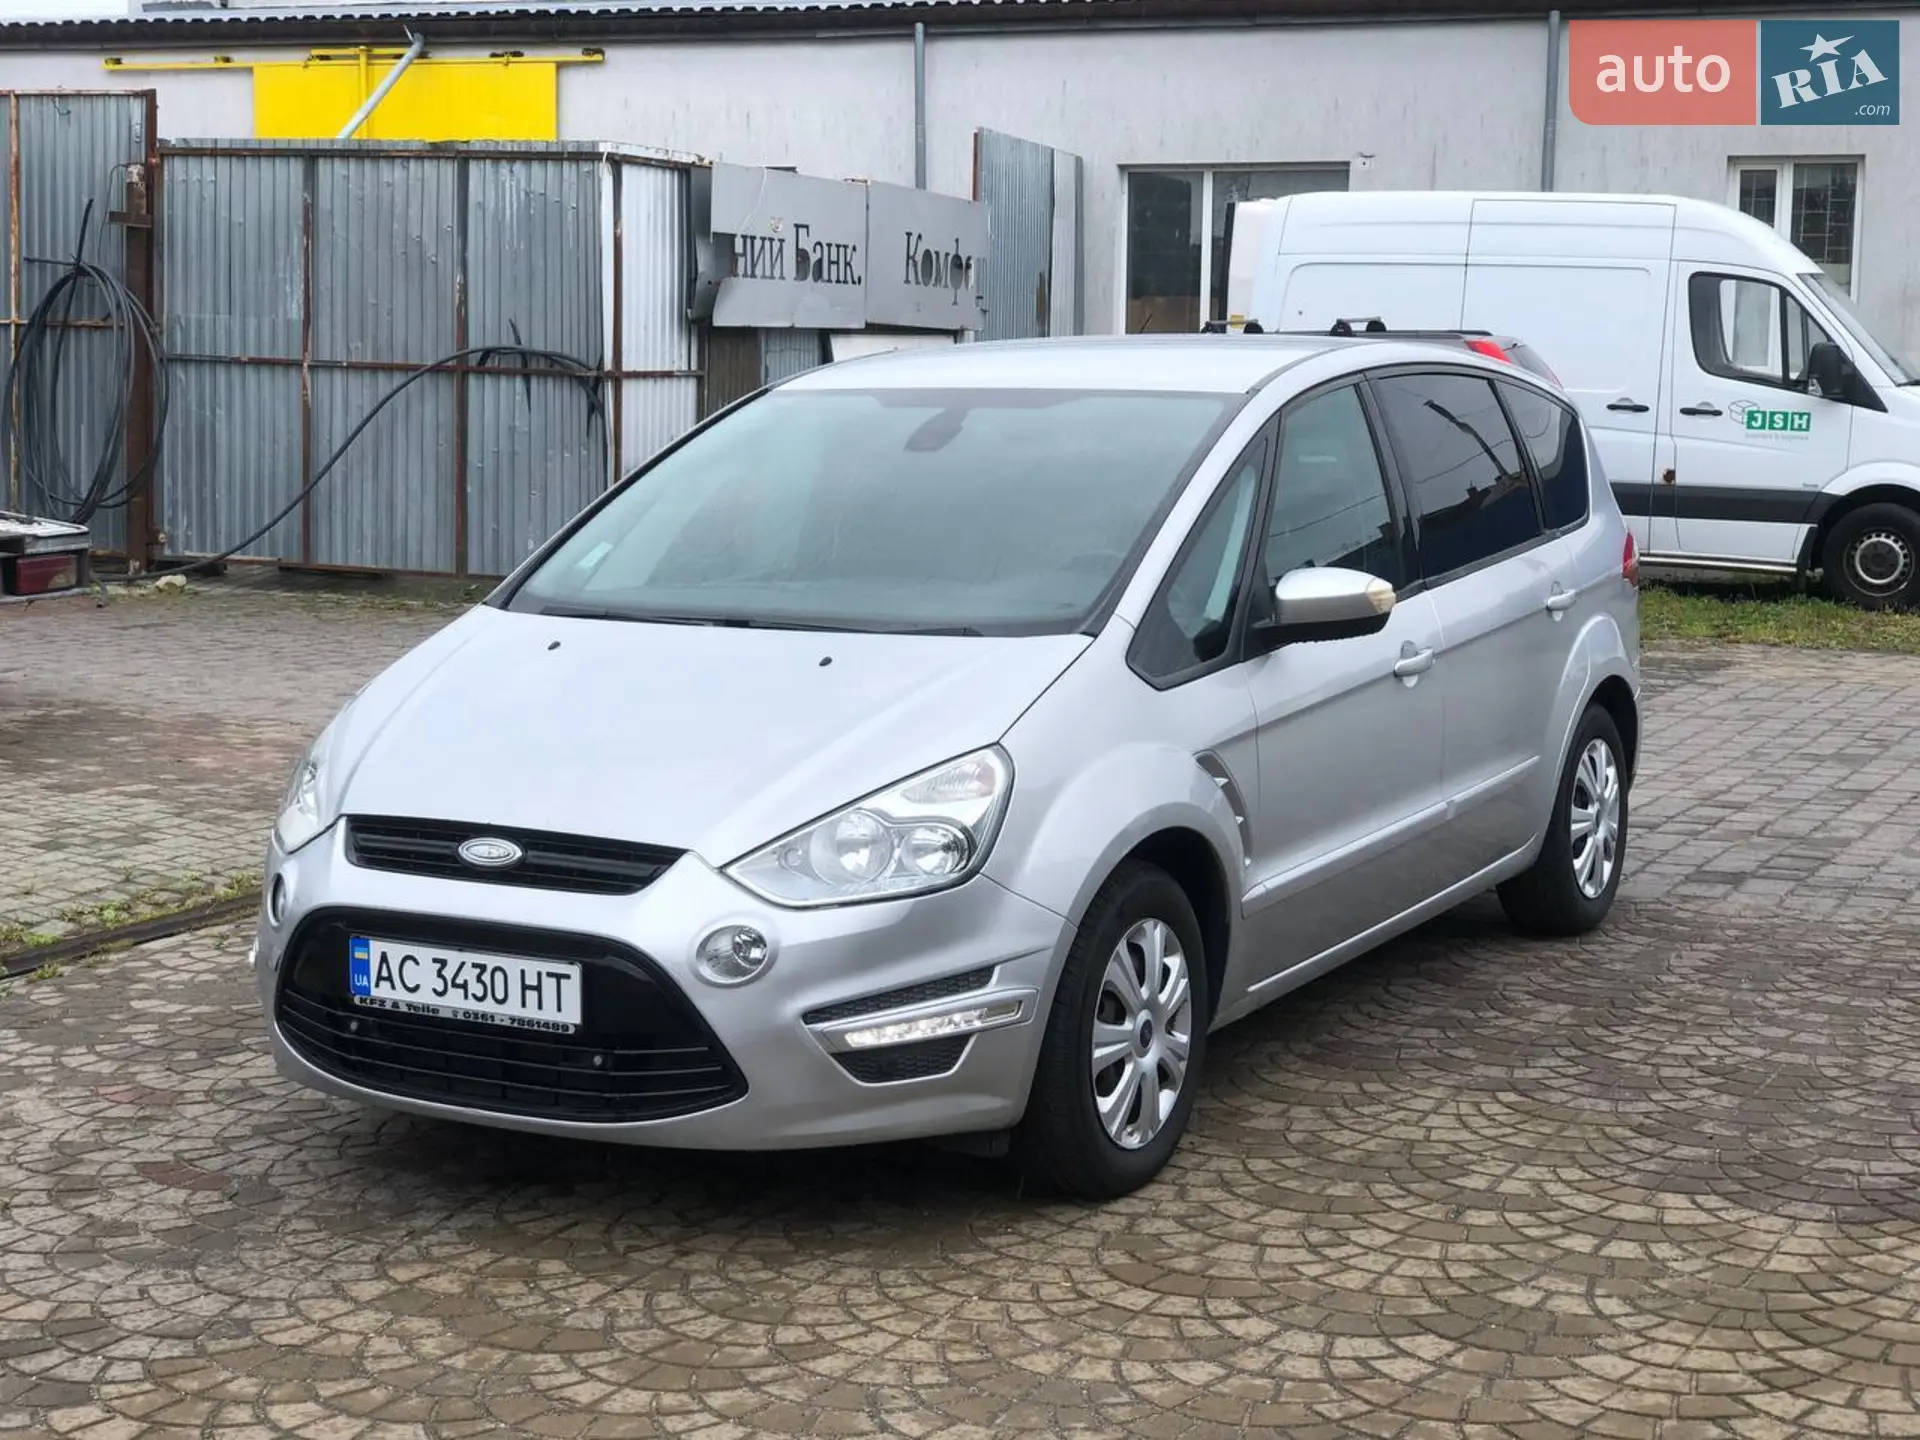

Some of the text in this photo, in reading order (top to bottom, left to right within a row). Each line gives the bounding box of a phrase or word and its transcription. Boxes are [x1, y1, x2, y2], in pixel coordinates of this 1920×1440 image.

[793, 223, 861, 285] Банк.
[1750, 412, 1810, 430] JSH
[354, 973, 369, 987] UA
[374, 950, 571, 1013] AC 3430 HT
[406, 1003, 440, 1015] Teile
